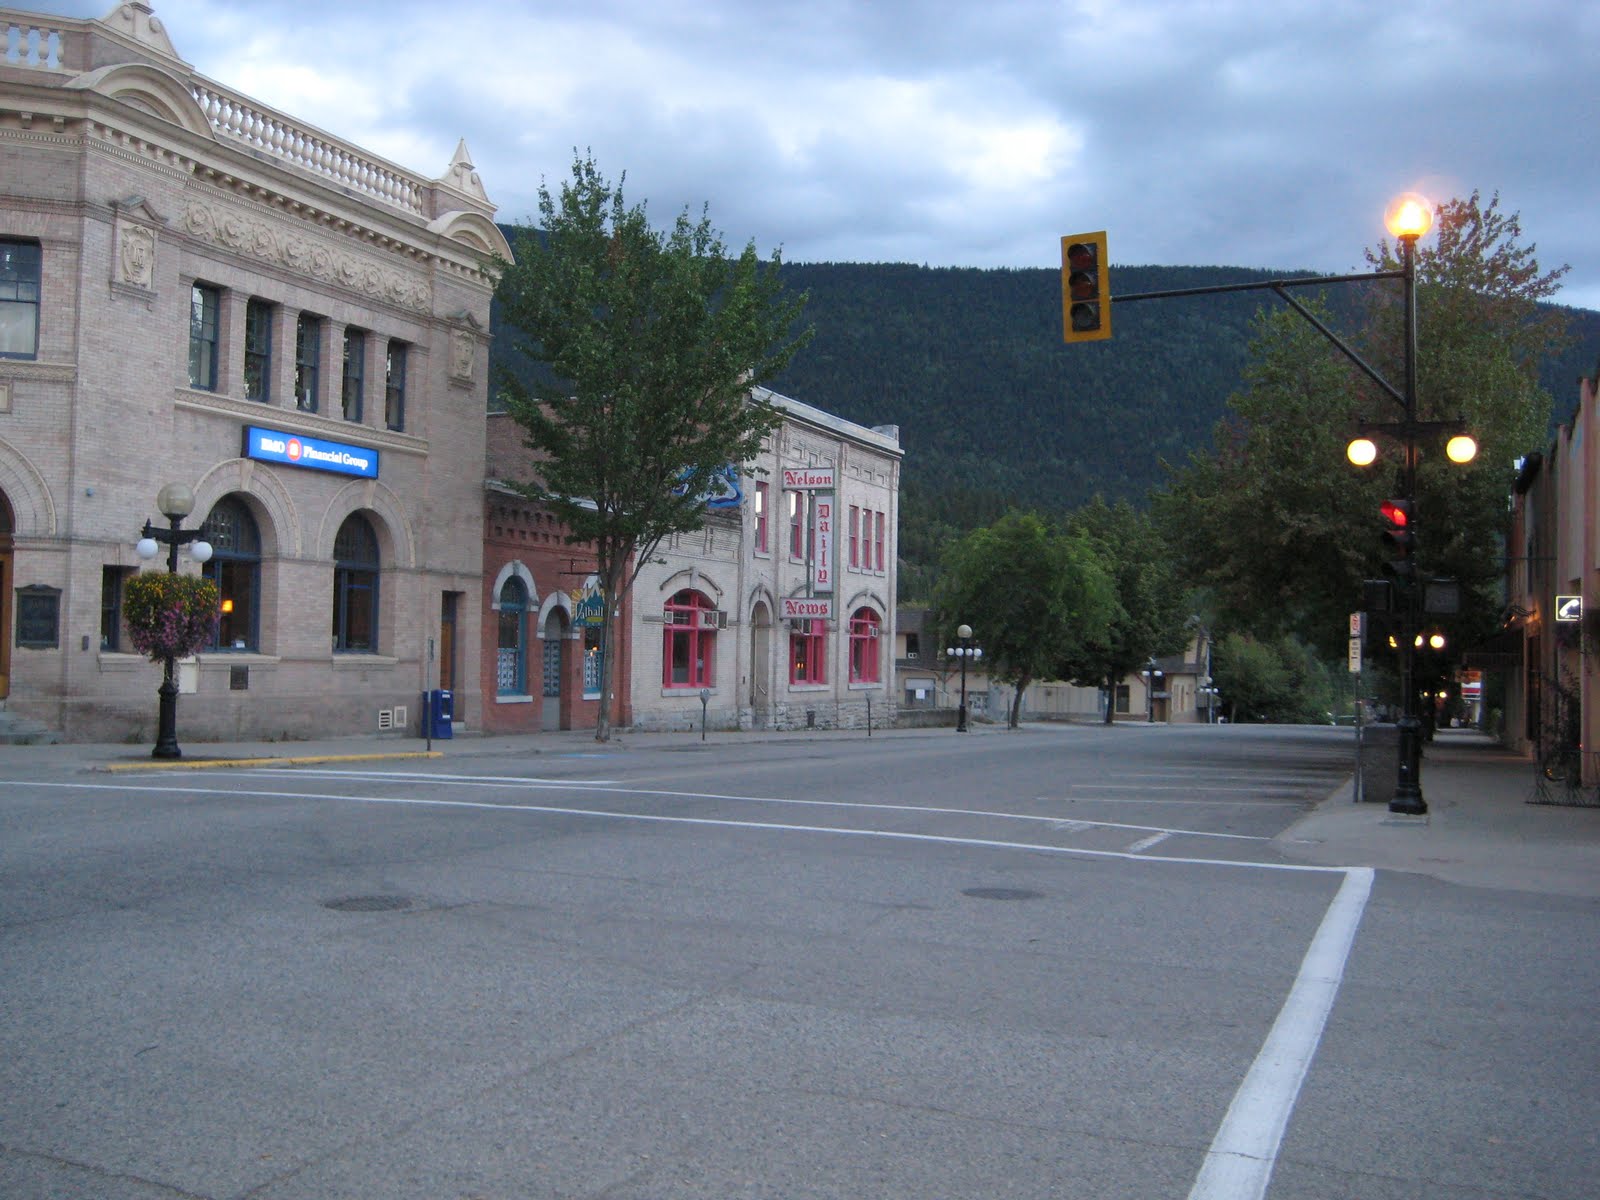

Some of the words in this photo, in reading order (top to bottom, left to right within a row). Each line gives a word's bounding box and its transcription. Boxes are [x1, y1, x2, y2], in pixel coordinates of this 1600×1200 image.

[303, 445, 342, 464] Financial
[343, 453, 368, 470] Group
[784, 471, 832, 486] Nelson
[817, 504, 830, 583] Daily
[575, 602, 604, 621] Valhall
[785, 600, 828, 616] News
